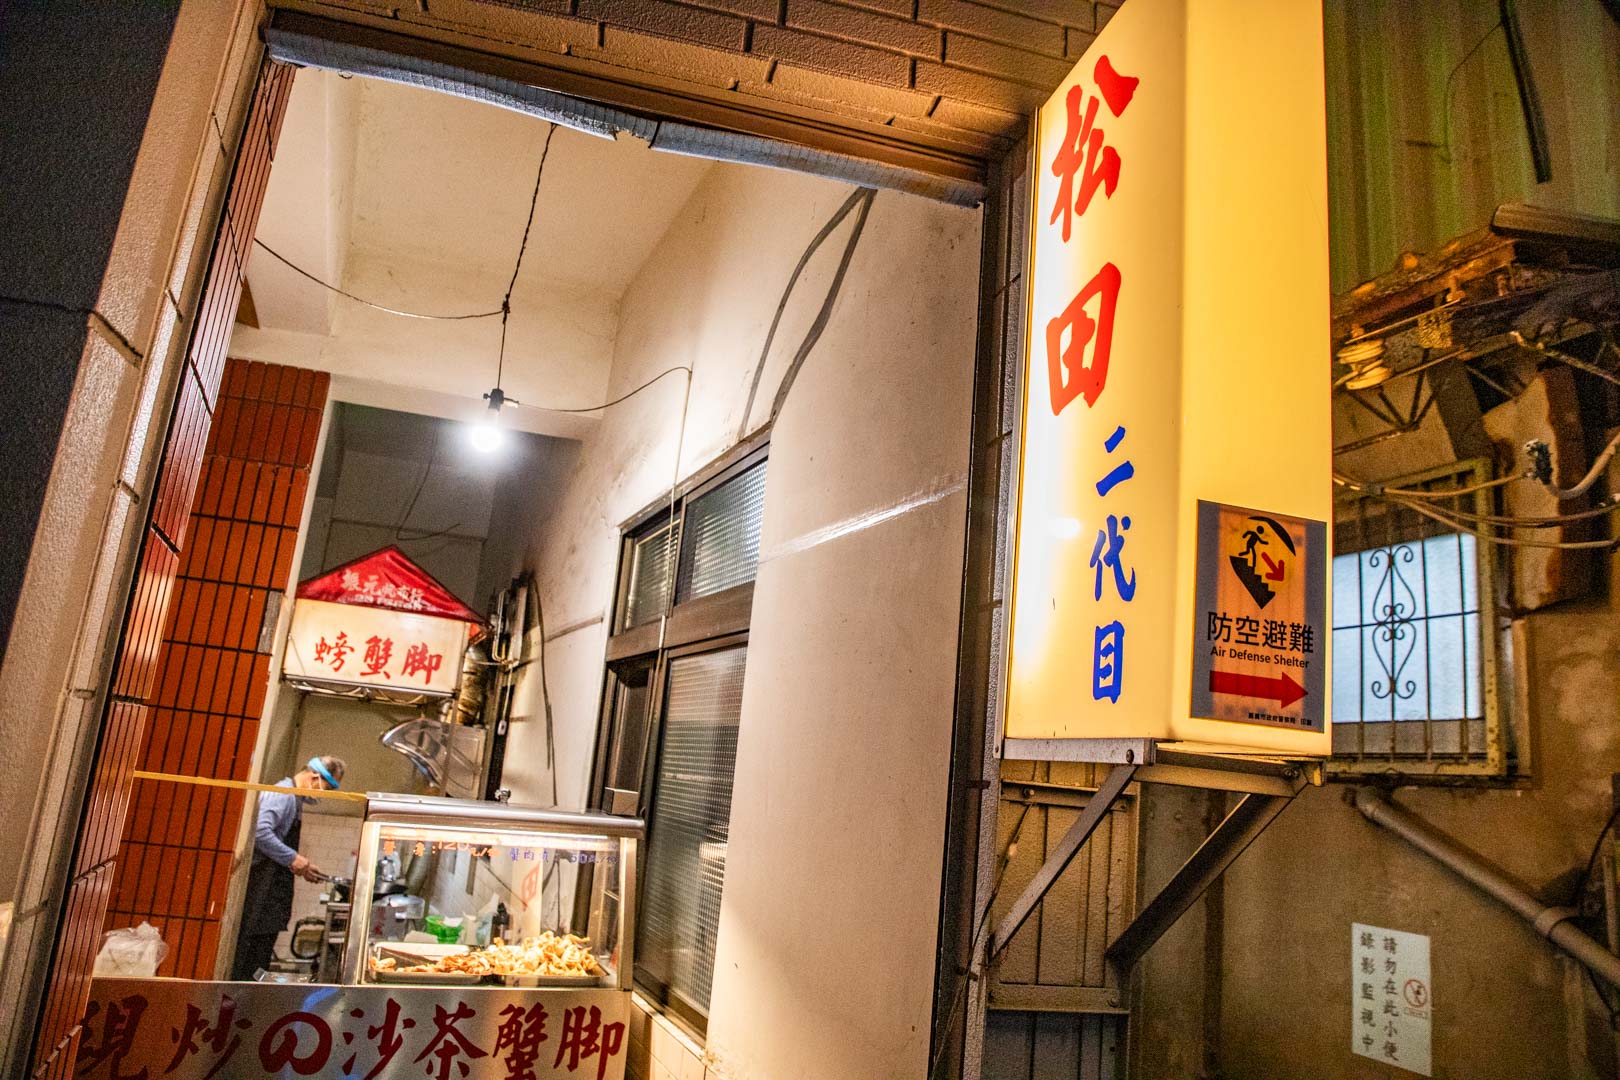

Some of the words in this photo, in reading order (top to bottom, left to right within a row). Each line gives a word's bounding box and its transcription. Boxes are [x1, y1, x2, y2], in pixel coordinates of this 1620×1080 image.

[1046, 55, 1139, 416] 松田
[1090, 426, 1137, 704] 二代目
[1207, 611, 1314, 654] 防空避難
[1210, 646, 1227, 657] Air
[1229, 648, 1271, 664] Defense
[1273, 654, 1310, 669] Shelter
[1383, 936, 1399, 1062] 請勿在此小便
